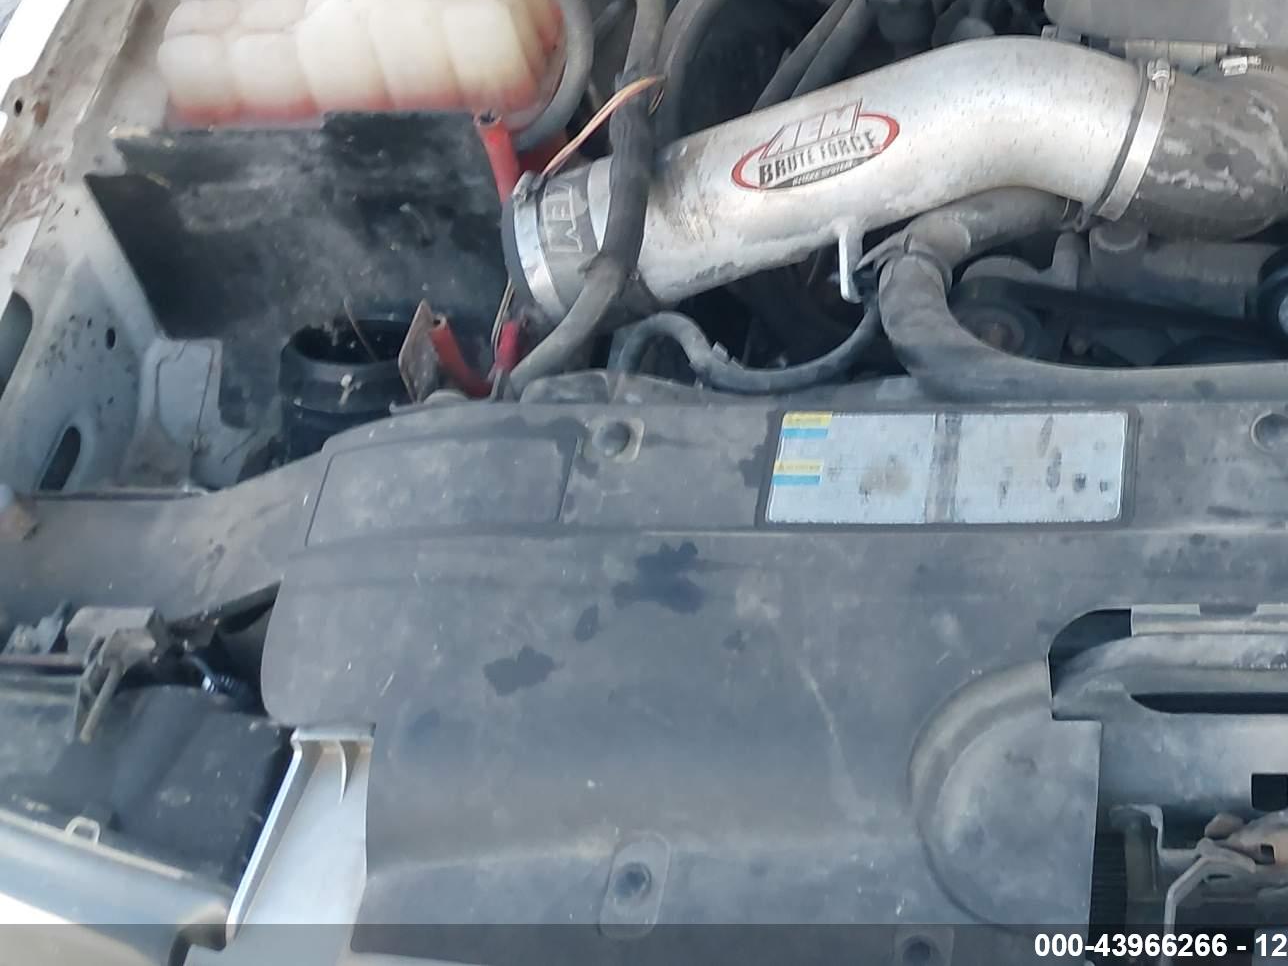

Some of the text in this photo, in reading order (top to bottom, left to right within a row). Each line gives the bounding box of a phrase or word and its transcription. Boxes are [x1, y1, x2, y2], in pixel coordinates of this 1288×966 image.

[758, 98, 863, 160] AEM
[759, 149, 815, 187] BRUTE
[819, 129, 877, 160] FORCE
